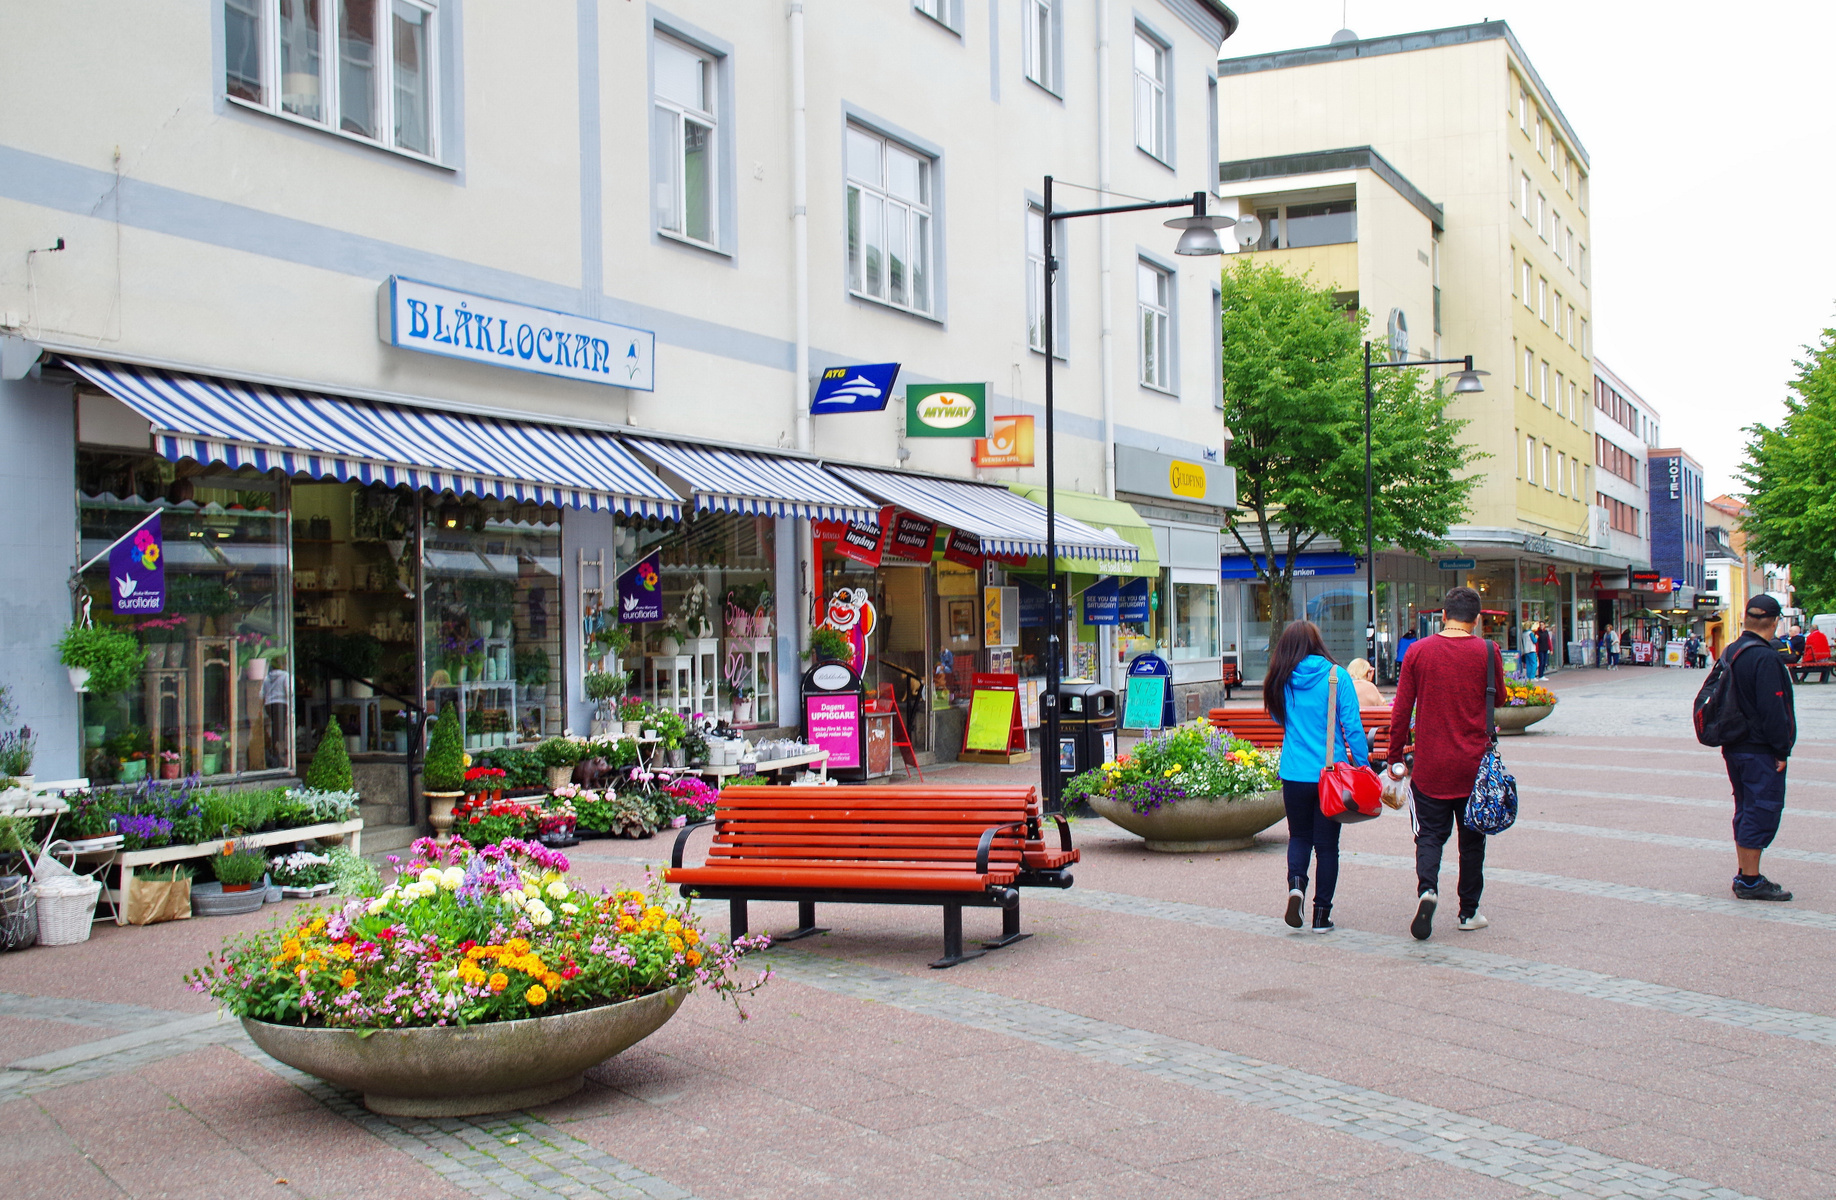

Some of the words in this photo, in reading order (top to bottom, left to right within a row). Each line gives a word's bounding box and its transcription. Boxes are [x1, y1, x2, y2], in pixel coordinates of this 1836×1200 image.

[407, 298, 610, 374] BLÅKLOCKAN
[824, 368, 846, 379] ATG
[923, 406, 971, 419] MYWAY
[1669, 457, 1679, 499] HOTEL
[118, 596, 160, 609] euroflorist
[622, 609, 659, 620] euroflorist
[821, 703, 845, 712] Dagens
[811, 711, 856, 720] UPPIGGARE
